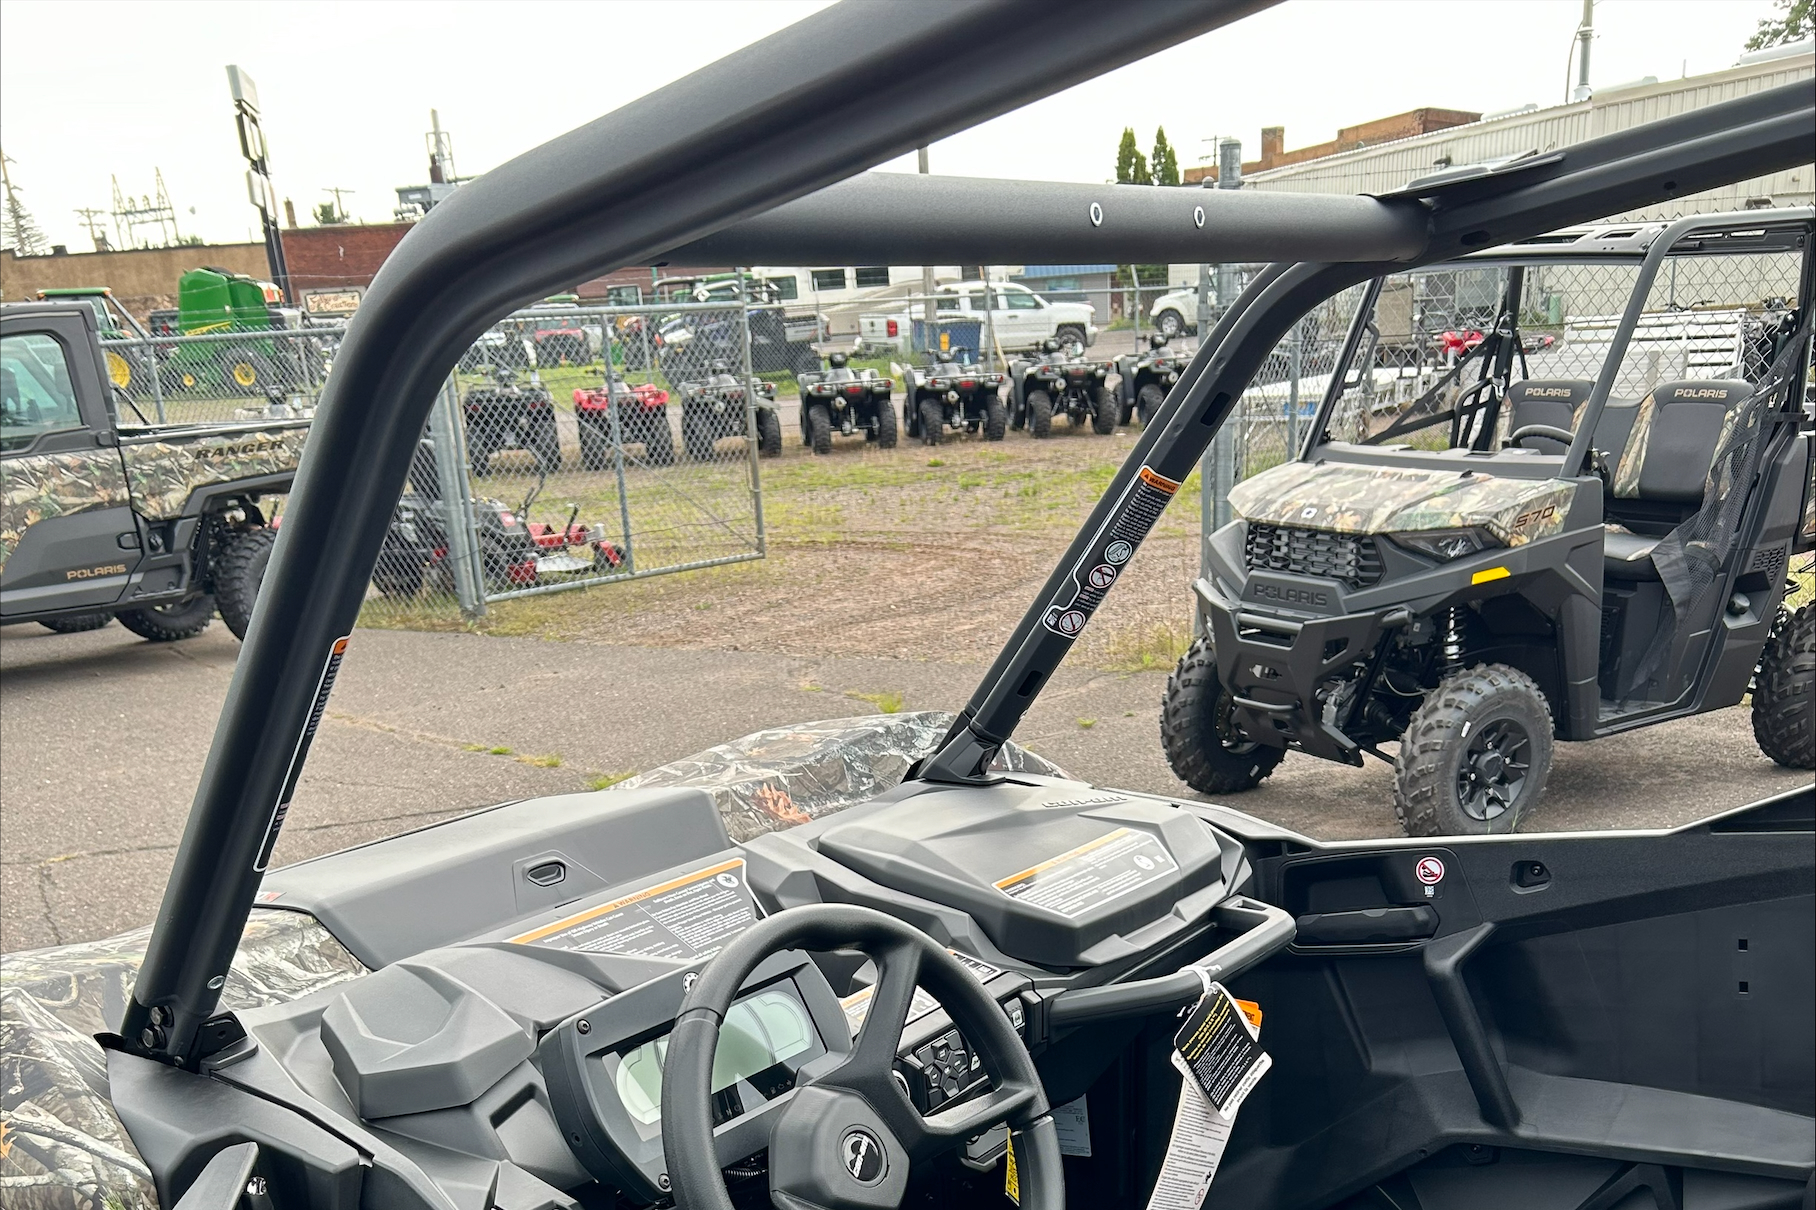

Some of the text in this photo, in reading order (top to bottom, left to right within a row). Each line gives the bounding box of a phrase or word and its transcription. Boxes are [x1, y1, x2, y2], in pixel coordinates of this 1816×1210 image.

[1525, 387, 1571, 397] POLARIS
[1674, 388, 1728, 399] POLARIS
[195, 440, 284, 460] RANGER
[1514, 504, 1557, 529] 570
[66, 564, 127, 580] POLARIS
[1254, 583, 1328, 607] POLARIS
